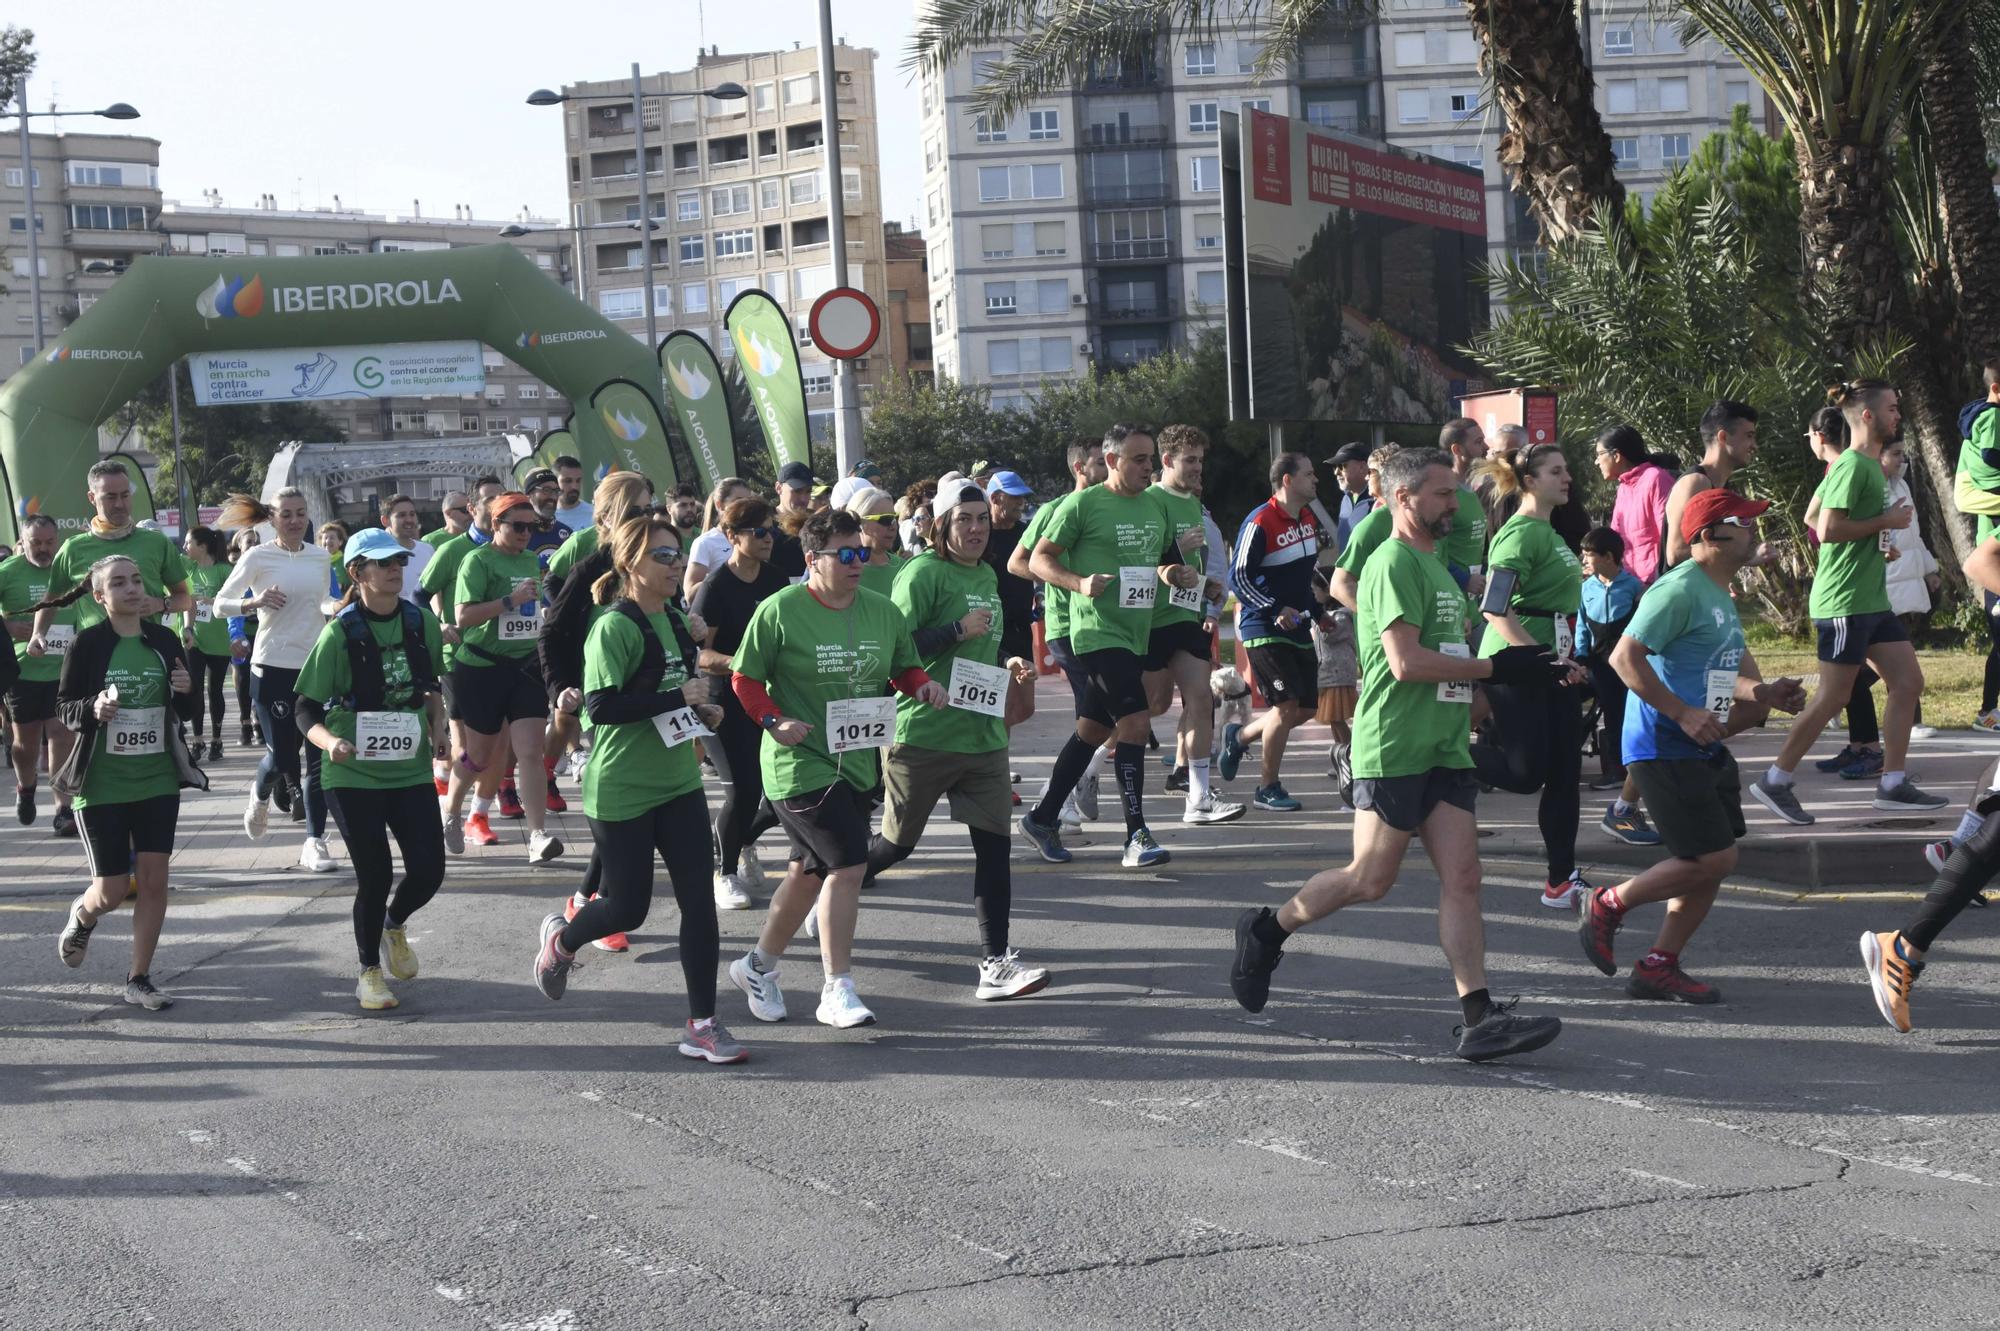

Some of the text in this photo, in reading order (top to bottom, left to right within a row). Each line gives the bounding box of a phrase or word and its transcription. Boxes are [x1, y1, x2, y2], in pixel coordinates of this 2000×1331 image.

[1311, 144, 1349, 173] MURCIA
[1382, 168, 1392, 183] DE
[1393, 170, 1447, 197] REVEGETACIÓN
[1446, 185, 1452, 197] Y
[1453, 187, 1480, 204] MEJORA
[1355, 183, 1366, 197] DE
[1367, 185, 1383, 200] LOS
[1383, 186, 1423, 210] MÁRGENES
[1424, 199, 1438, 213] DEL
[273, 278, 462, 312] IBERDROLA
[541, 330, 607, 344] IBERDROLA
[71, 349, 143, 360] IBERDROLA
[208, 359, 248, 369] Murcia
[210, 368, 270, 379] en marcha
[390, 368, 418, 376] contra
[211, 380, 247, 389] contra
[211, 389, 223, 399] el
[1277, 522, 1314, 547] adidas
[1174, 587, 1198, 602] 2213
[506, 620, 538, 632] 0991
[816, 643, 842, 651] Murcia
[829, 650, 858, 658] marcha
[817, 658, 843, 666] contra
[959, 684, 998, 706] 1015
[116, 730, 157, 745] 0856
[836, 723, 885, 741] 1012
[366, 736, 412, 750] 2209
